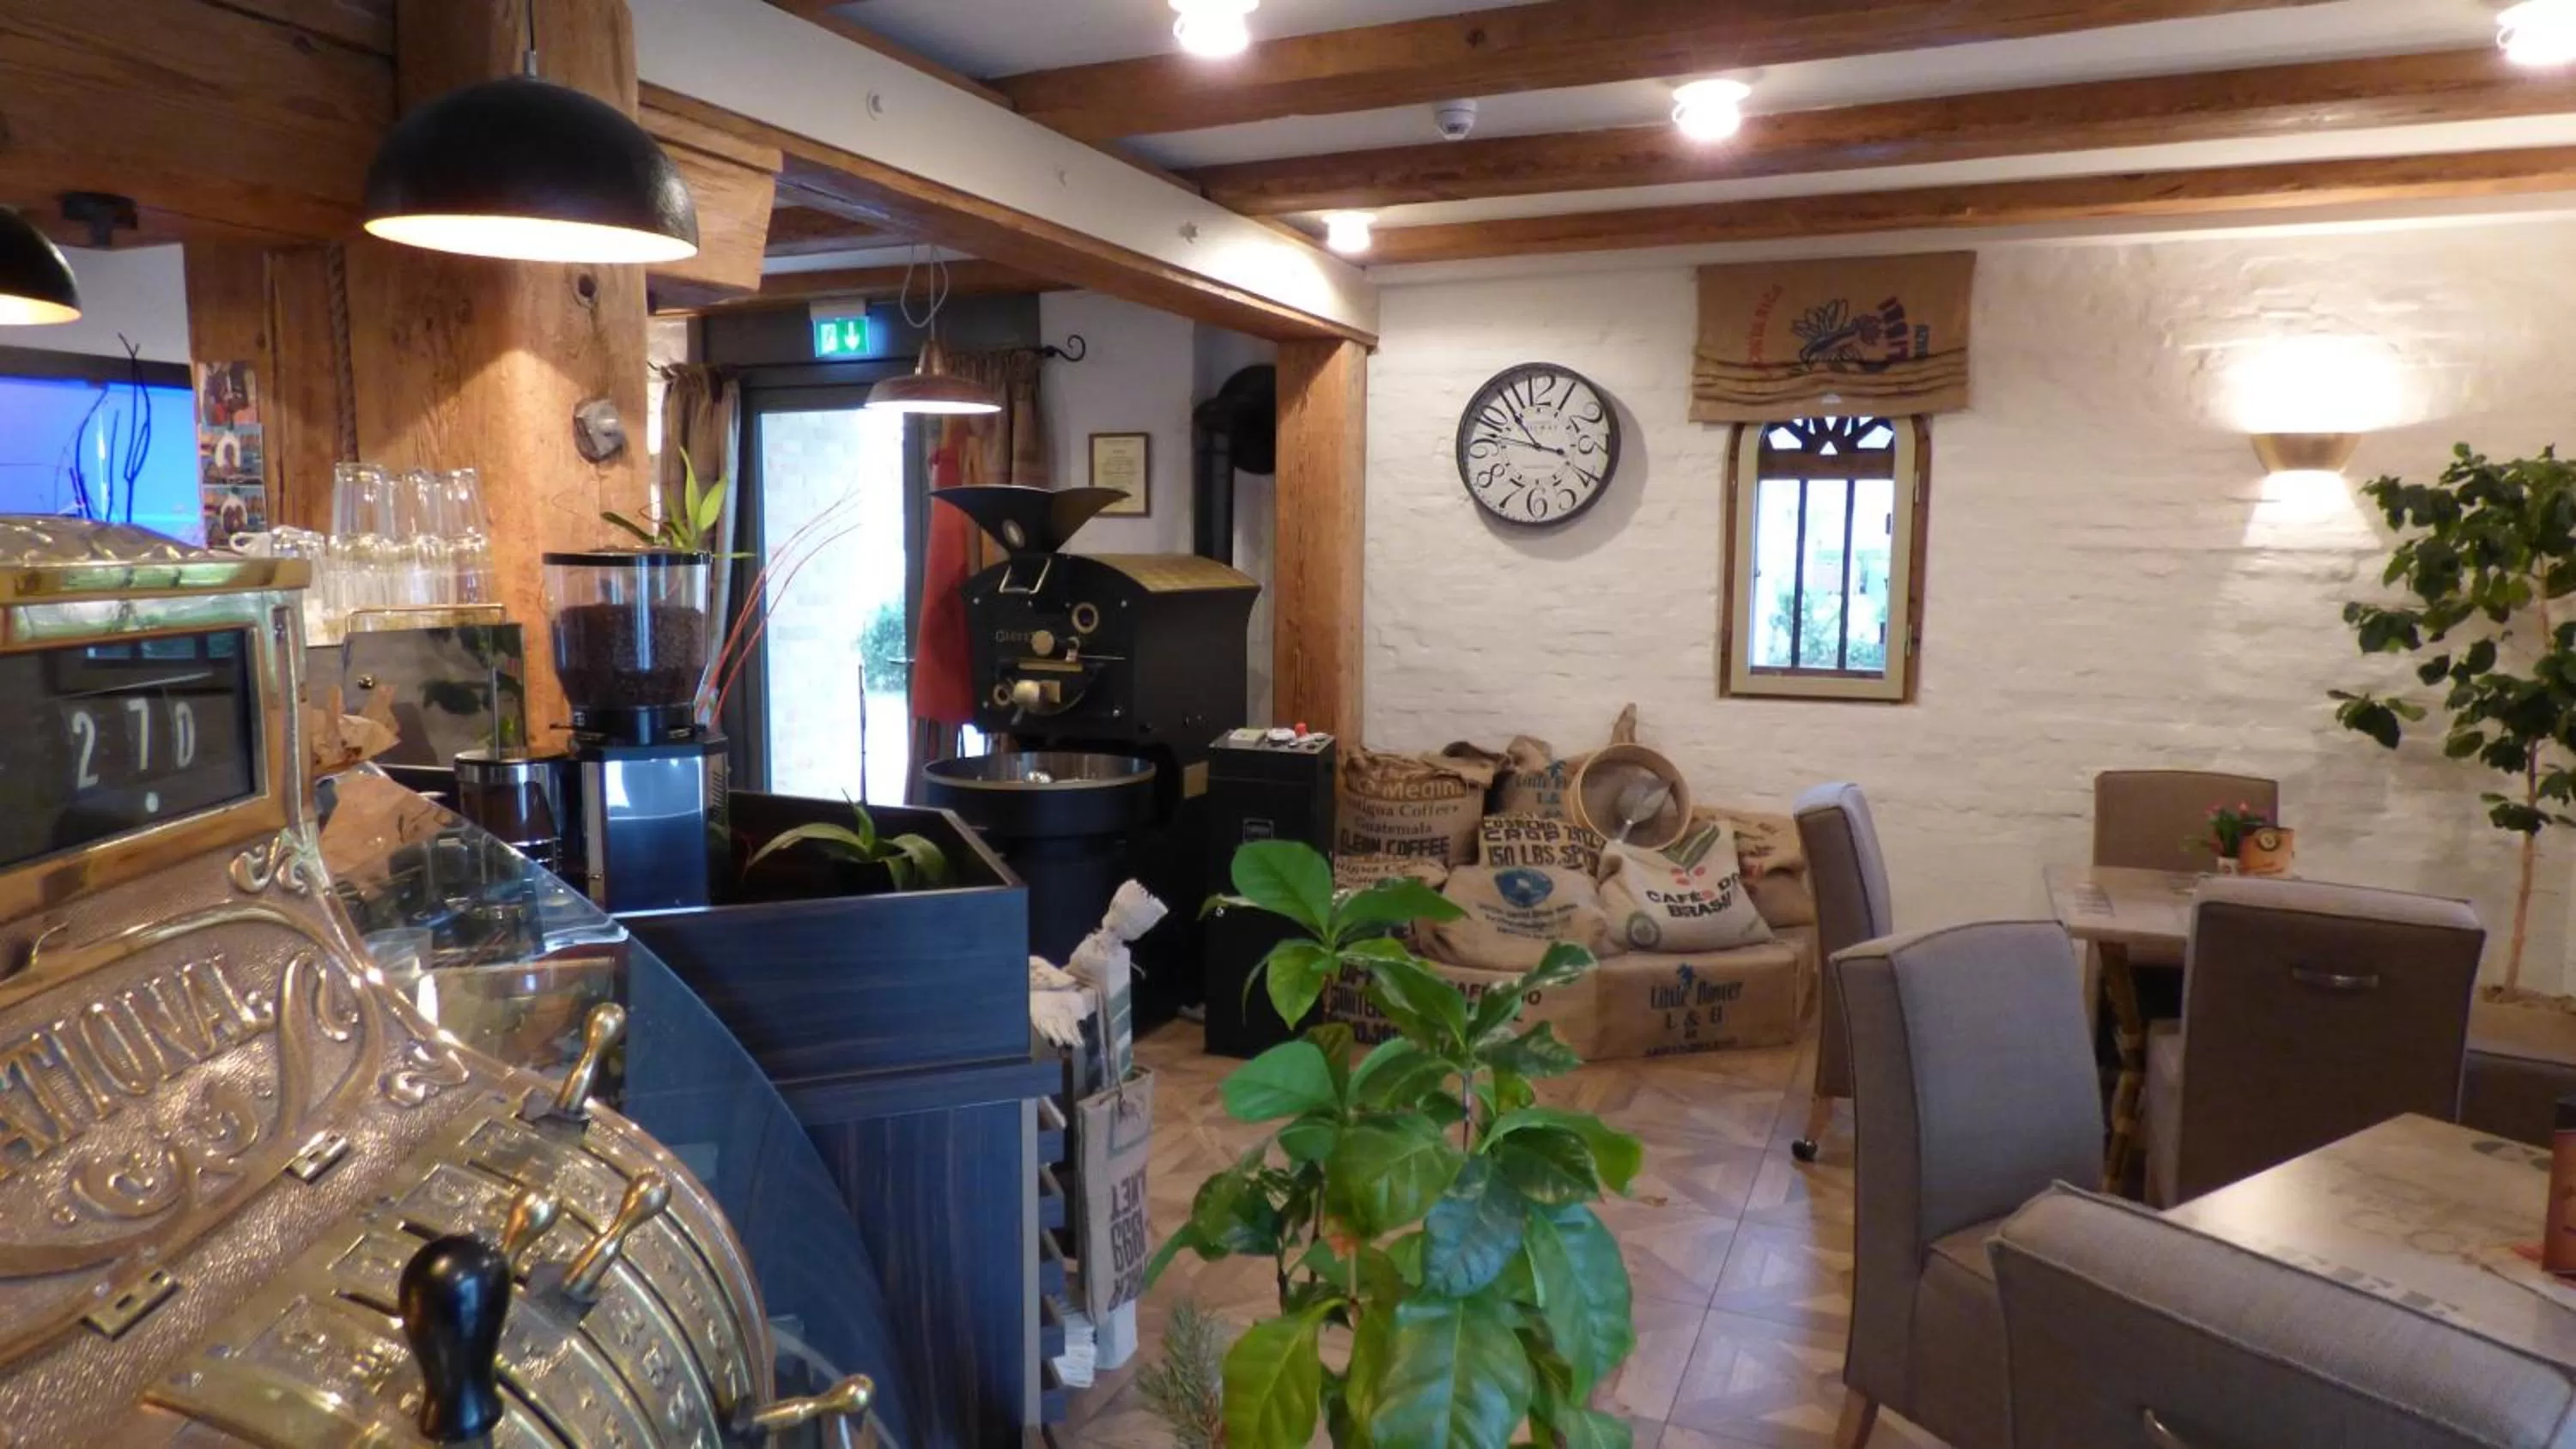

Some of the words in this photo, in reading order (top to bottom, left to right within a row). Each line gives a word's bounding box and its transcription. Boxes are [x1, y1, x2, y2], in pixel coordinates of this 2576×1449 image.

[1528, 374, 1556, 407] 12
[1558, 381, 1577, 410] 1
[1474, 404, 1508, 433] 10
[1570, 401, 1603, 433] 2
[1468, 438, 1499, 459] 9
[1577, 433, 1610, 456] 3
[1476, 463, 1505, 488] 8
[1571, 463, 1601, 488] 4
[1498, 477, 1525, 508] 7
[1526, 487, 1548, 518] 6
[1552, 478, 1577, 511] 5
[1385, 834, 1451, 858] COFFEE
